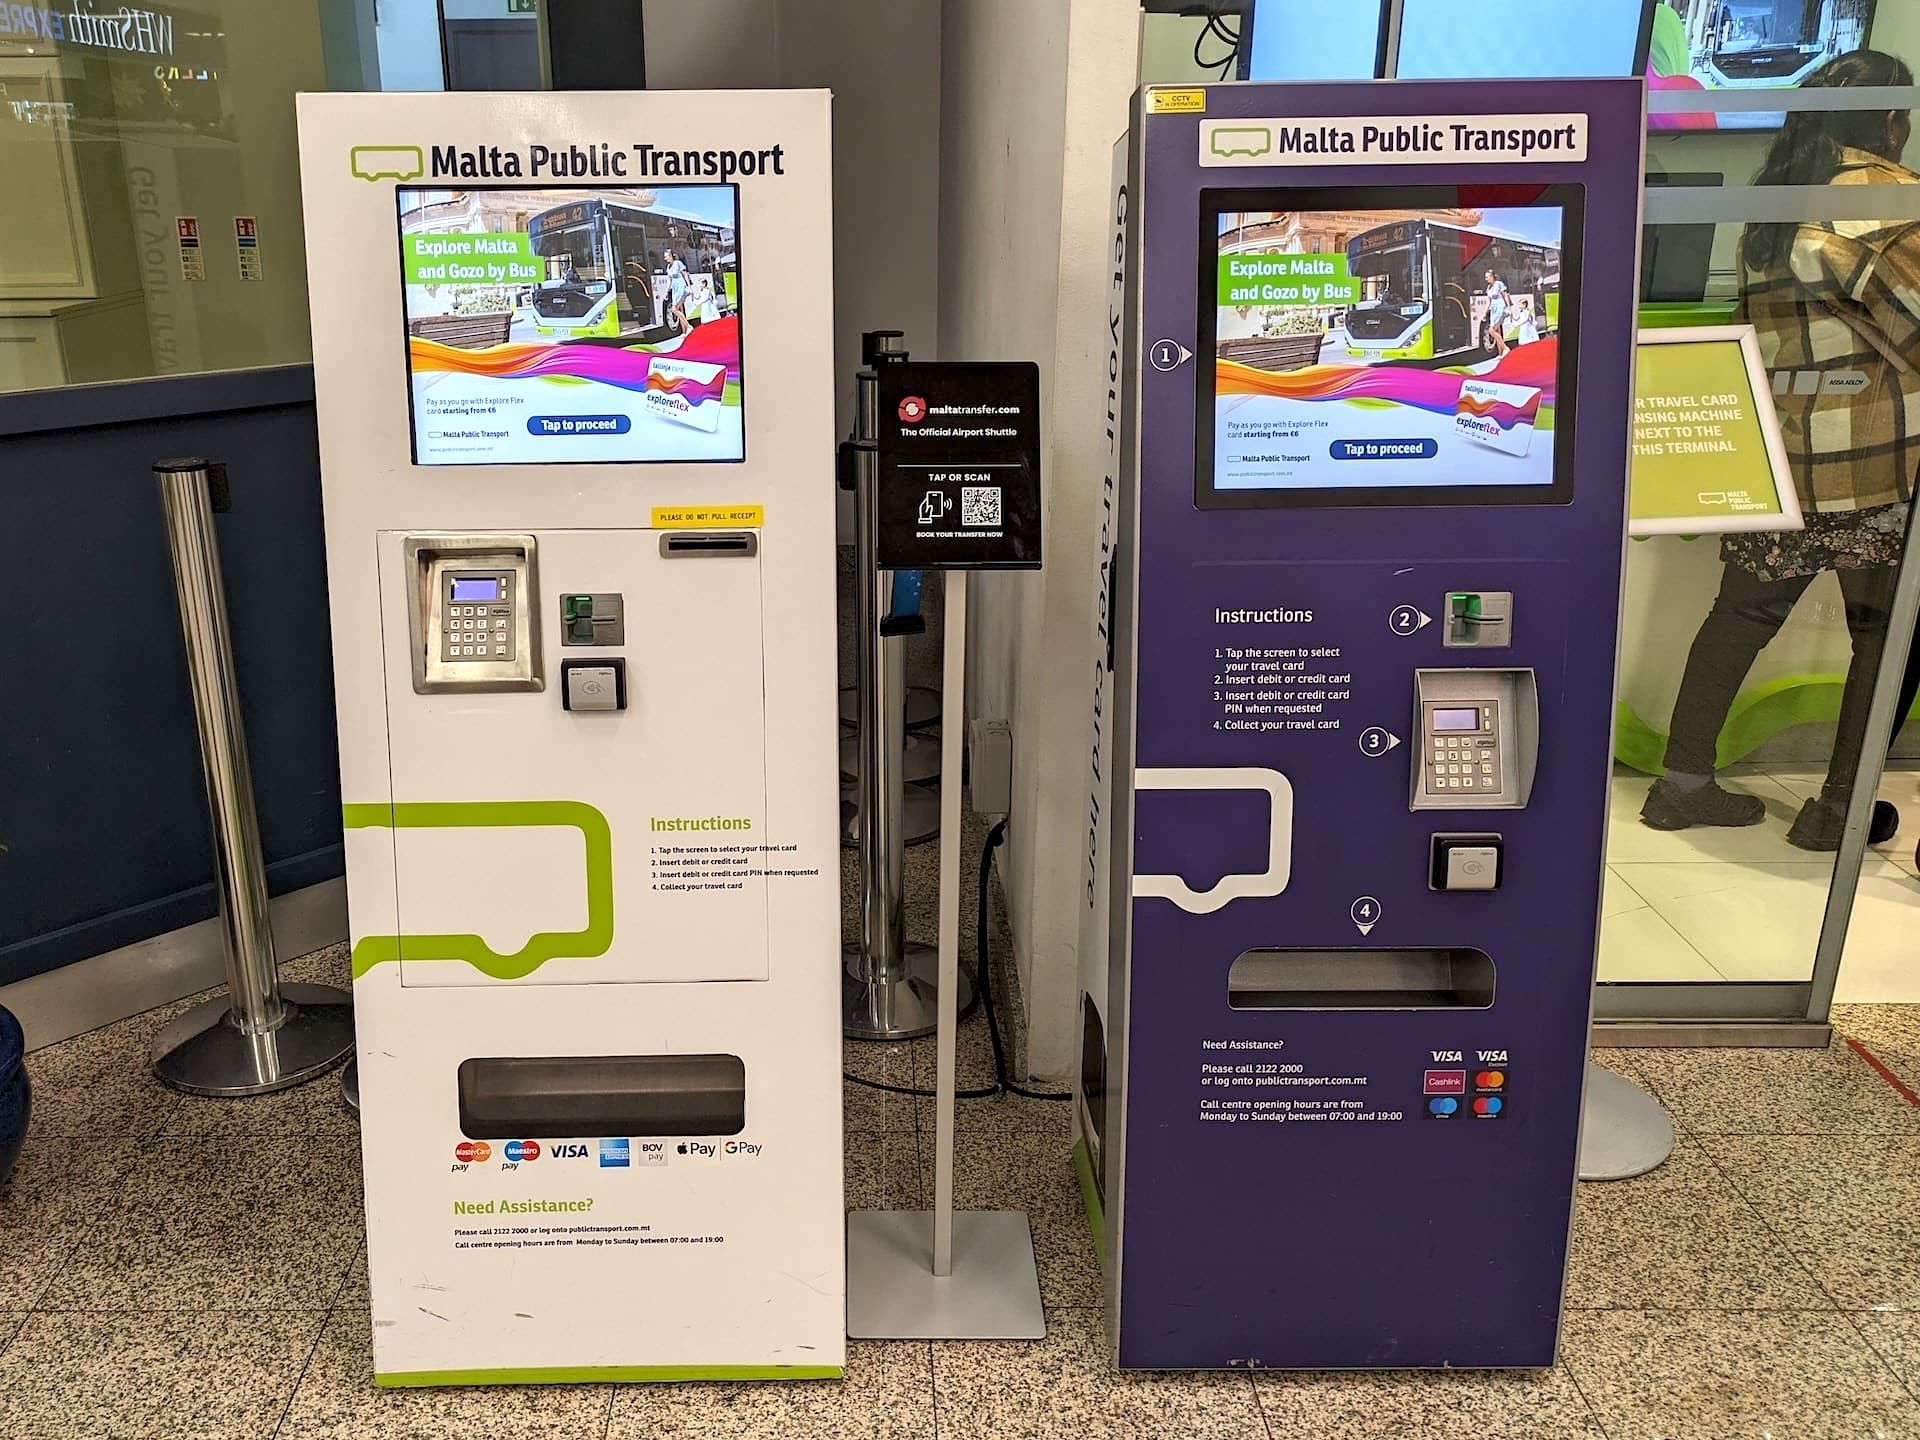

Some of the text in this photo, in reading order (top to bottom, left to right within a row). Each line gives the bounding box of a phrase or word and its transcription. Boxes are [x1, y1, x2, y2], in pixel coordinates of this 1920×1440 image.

[1279, 123, 1576, 157] Malta Public Transport
[431, 143, 785, 184] Malta Public Transport
[1114, 184, 1128, 291] Get
[415, 238, 518, 258] Explore Malta
[418, 263, 537, 281] and Gozo by Bus
[1230, 260, 1334, 279] Explore Malta
[1230, 283, 1352, 304] and Gozo by Bus
[1161, 347, 1170, 362] 1
[1106, 303, 1119, 457] your
[647, 394, 690, 413] exploreflex
[1646, 397, 1699, 408] TRAVEL
[1701, 394, 1738, 407] CARD
[929, 404, 1020, 414] maltatransfer.com
[1679, 409, 1743, 423] MACHINE
[541, 418, 616, 433] Tap to proceed
[900, 427, 1017, 438] The Official Airport Shuttle
[1456, 417, 1500, 437] exploreflex
[1634, 425, 1723, 440] NEXT TO THE
[1344, 442, 1423, 457] Tap to proceed
[1632, 440, 1737, 456] THIS TERMINAL
[928, 473, 990, 481] TAP OR SCAN
[711, 512, 727, 520] PULL
[1214, 608, 1313, 624] Instructions
[1399, 612, 1411, 628] 2
[1215, 647, 1340, 660] 1. Tap the screen to select
[1224, 660, 1304, 673] your travel card
[1214, 673, 1350, 684] 2. Insert debit or credit card
[1213, 689, 1349, 702] 3. Insert debit or credit card
[1224, 703, 1322, 715] PIN when requested
[1092, 659, 1103, 784] card
[1213, 719, 1339, 731] 4. Collect your travel card
[1369, 734, 1380, 749] 3
[650, 816, 752, 832] Instructions
[1086, 791, 1099, 910] here
[1360, 904, 1371, 918] 4
[1202, 1040, 1284, 1050] Need Assistance?
[1431, 1050, 1462, 1062] VISA
[1476, 1050, 1508, 1062] VISA
[1202, 1064, 1303, 1073] Please call 2122 2000
[1201, 1076, 1366, 1087] or log onto publictransport.com.mt
[1428, 1078, 1461, 1086] Cashlink
[1200, 1100, 1219, 1108] Call
[1221, 1100, 1251, 1108] centre
[1253, 1099, 1291, 1110] opening
[1293, 1099, 1320, 1108] hours
[1340, 1099, 1363, 1108] from
[1200, 1111, 1402, 1122] Monday to Sunday between 07:00 and 19:00
[456, 1147, 491, 1156] MasterCard
[508, 1146, 538, 1155] Maestro
[551, 1144, 589, 1158] VISA
[642, 1144, 663, 1152] BOV
[690, 1142, 716, 1158] Pay
[648, 1153, 664, 1161] pay
[451, 1162, 469, 1172] pay
[502, 1162, 519, 1172] pay
[454, 1197, 594, 1214] Need Assistance?
